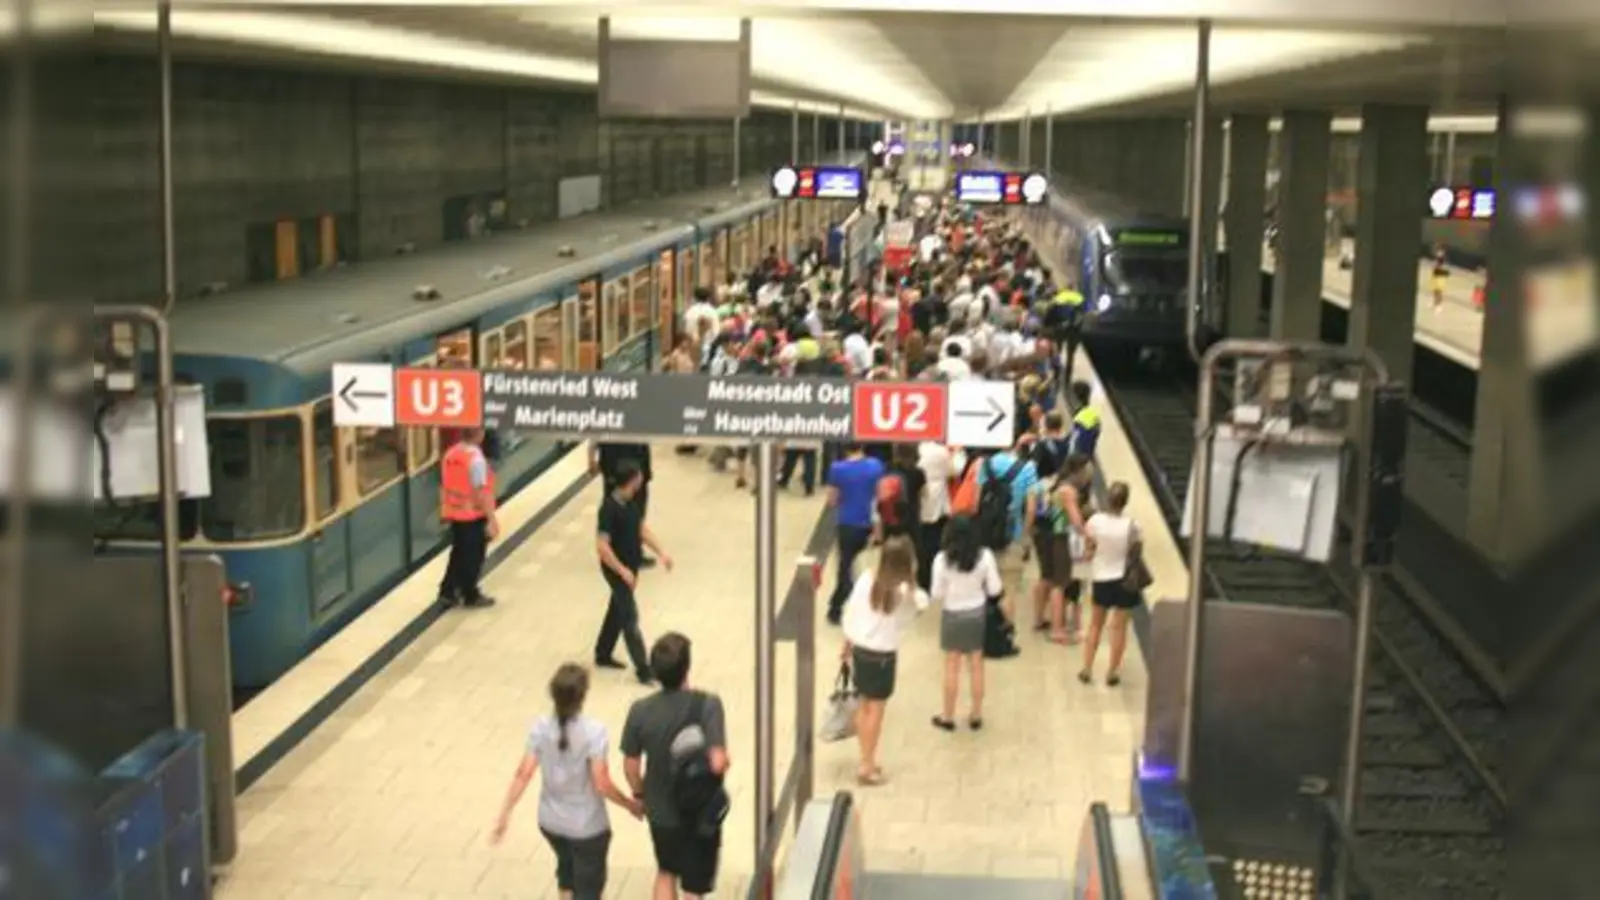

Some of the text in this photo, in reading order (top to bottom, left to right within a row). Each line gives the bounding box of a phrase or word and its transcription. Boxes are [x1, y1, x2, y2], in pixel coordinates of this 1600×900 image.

[411, 378, 464, 416] U3
[484, 374, 638, 399] Fürstenried West
[708, 380, 849, 406] Messestadt Ost
[514, 404, 623, 432] Marienplatz
[714, 411, 849, 438] Hauptbahnhof
[870, 392, 928, 432] U2
